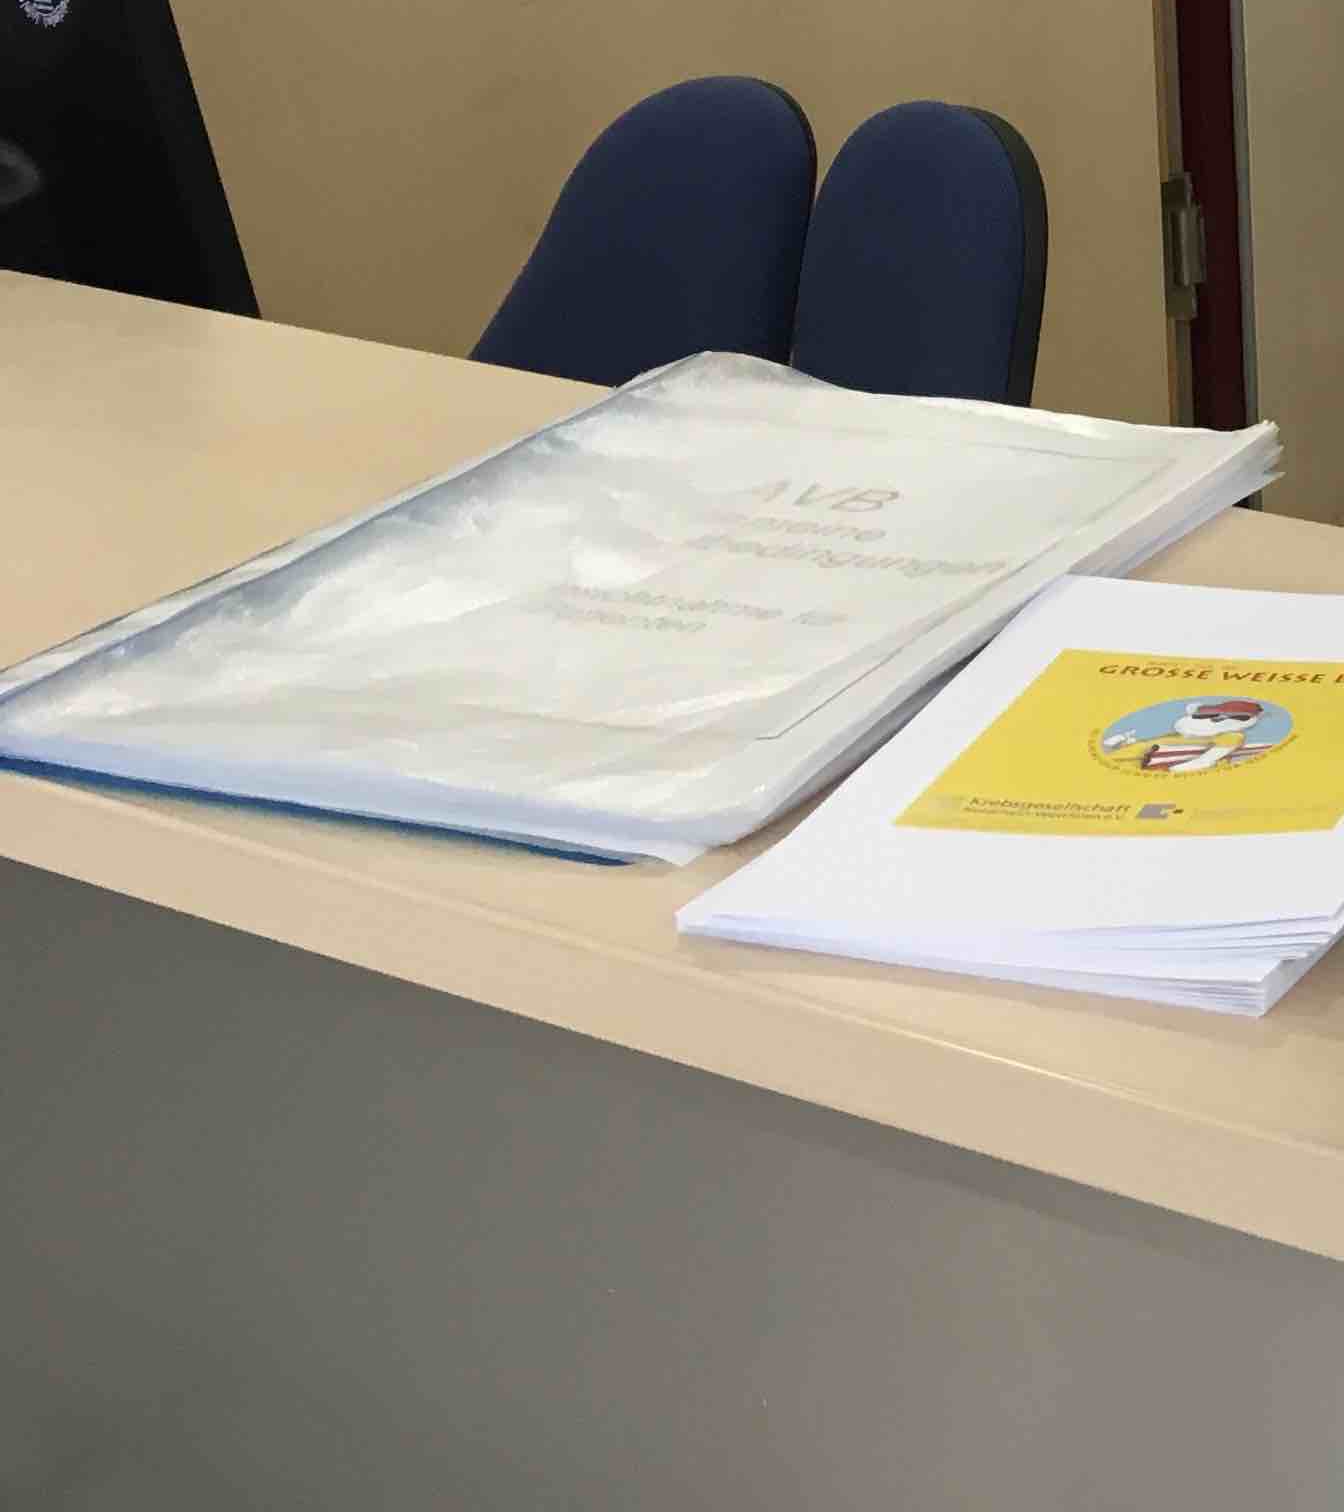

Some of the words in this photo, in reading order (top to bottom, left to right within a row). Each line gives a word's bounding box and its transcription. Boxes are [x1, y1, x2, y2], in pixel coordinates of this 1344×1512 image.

[1098, 664, 1214, 681] GROSSE
[1221, 671, 1326, 684] WEISSE
[968, 796, 1132, 813] Krebsgesellschaft
